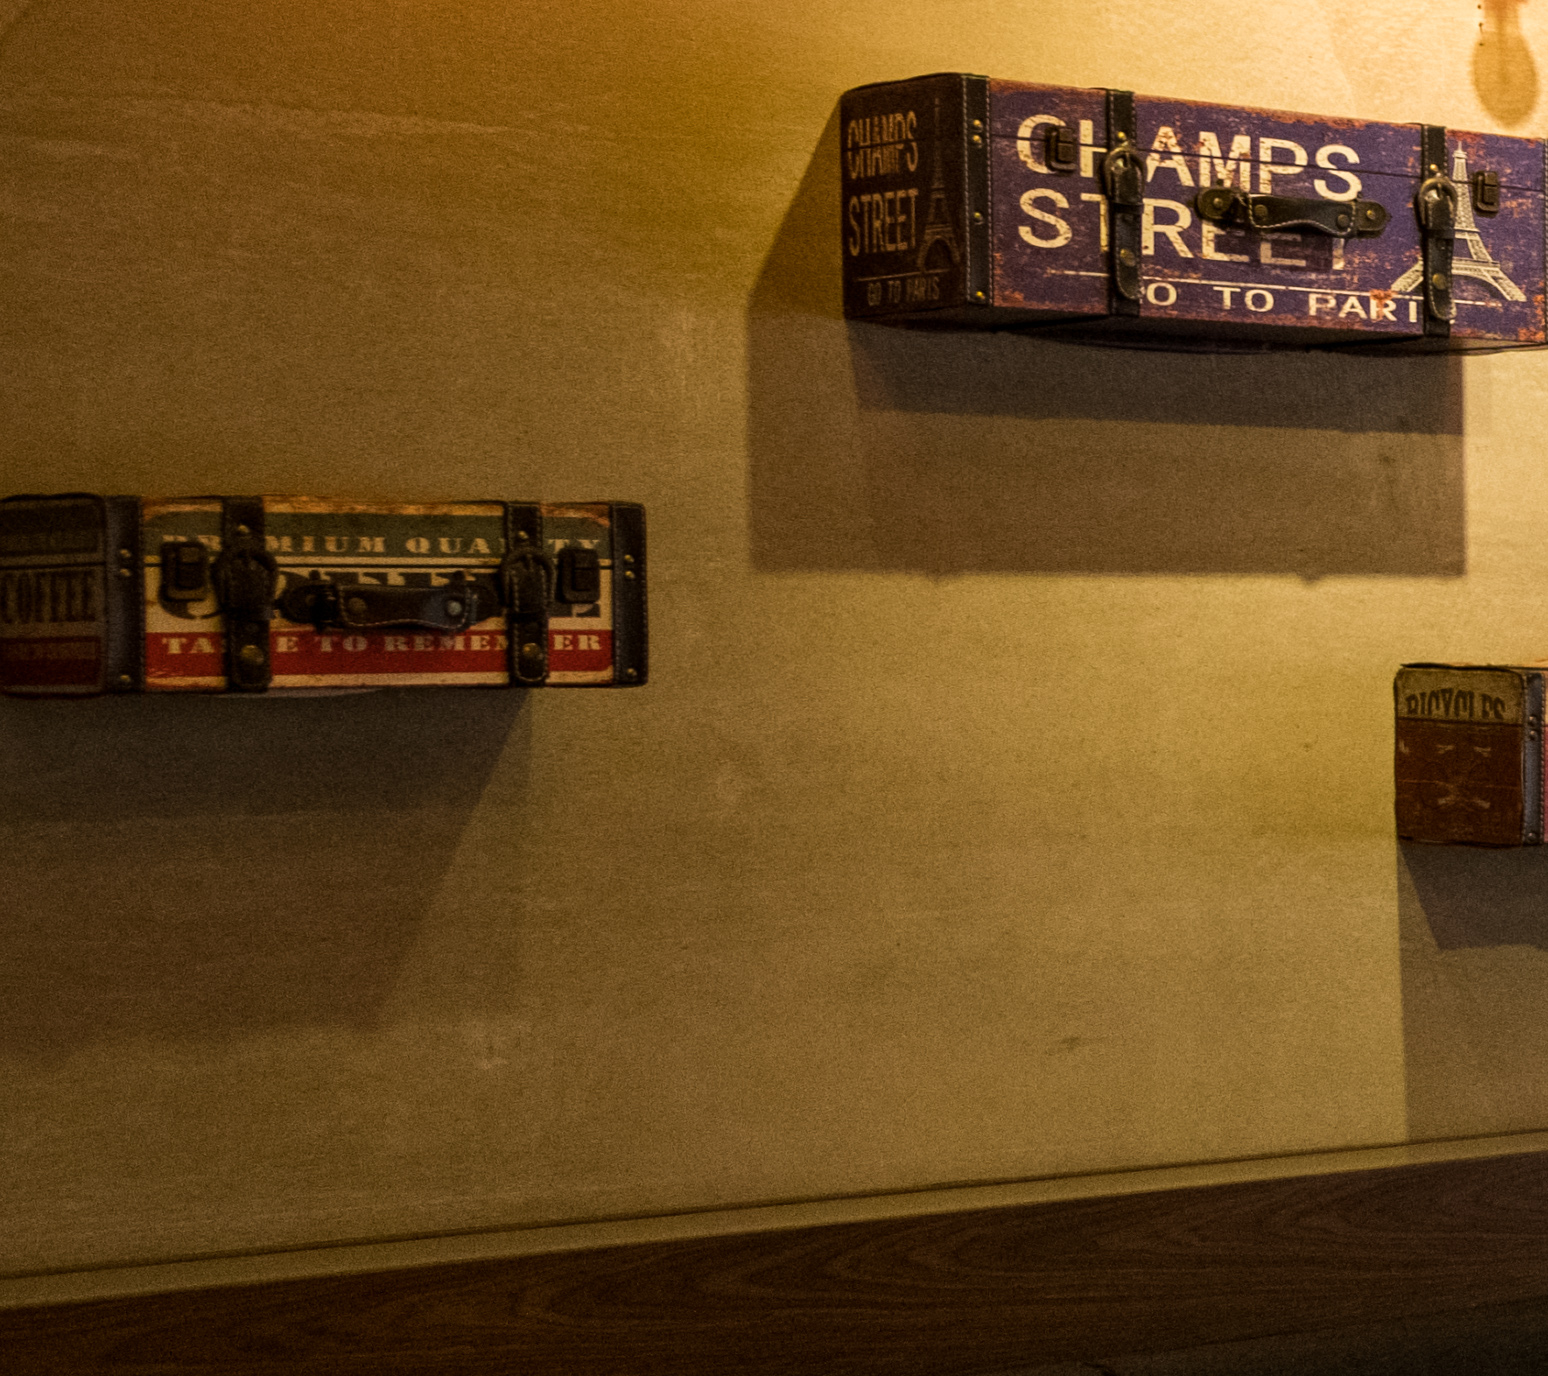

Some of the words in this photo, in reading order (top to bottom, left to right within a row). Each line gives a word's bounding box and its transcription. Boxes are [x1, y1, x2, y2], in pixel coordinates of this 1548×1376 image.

[848, 110, 918, 179] CHAMPS
[849, 188, 919, 256] STREET
[1138, 282, 1177, 307] O
[1213, 286, 1275, 313] TO
[1307, 292, 1456, 324] PARI
[162, 636, 299, 655] TAE
[314, 636, 369, 653] TO
